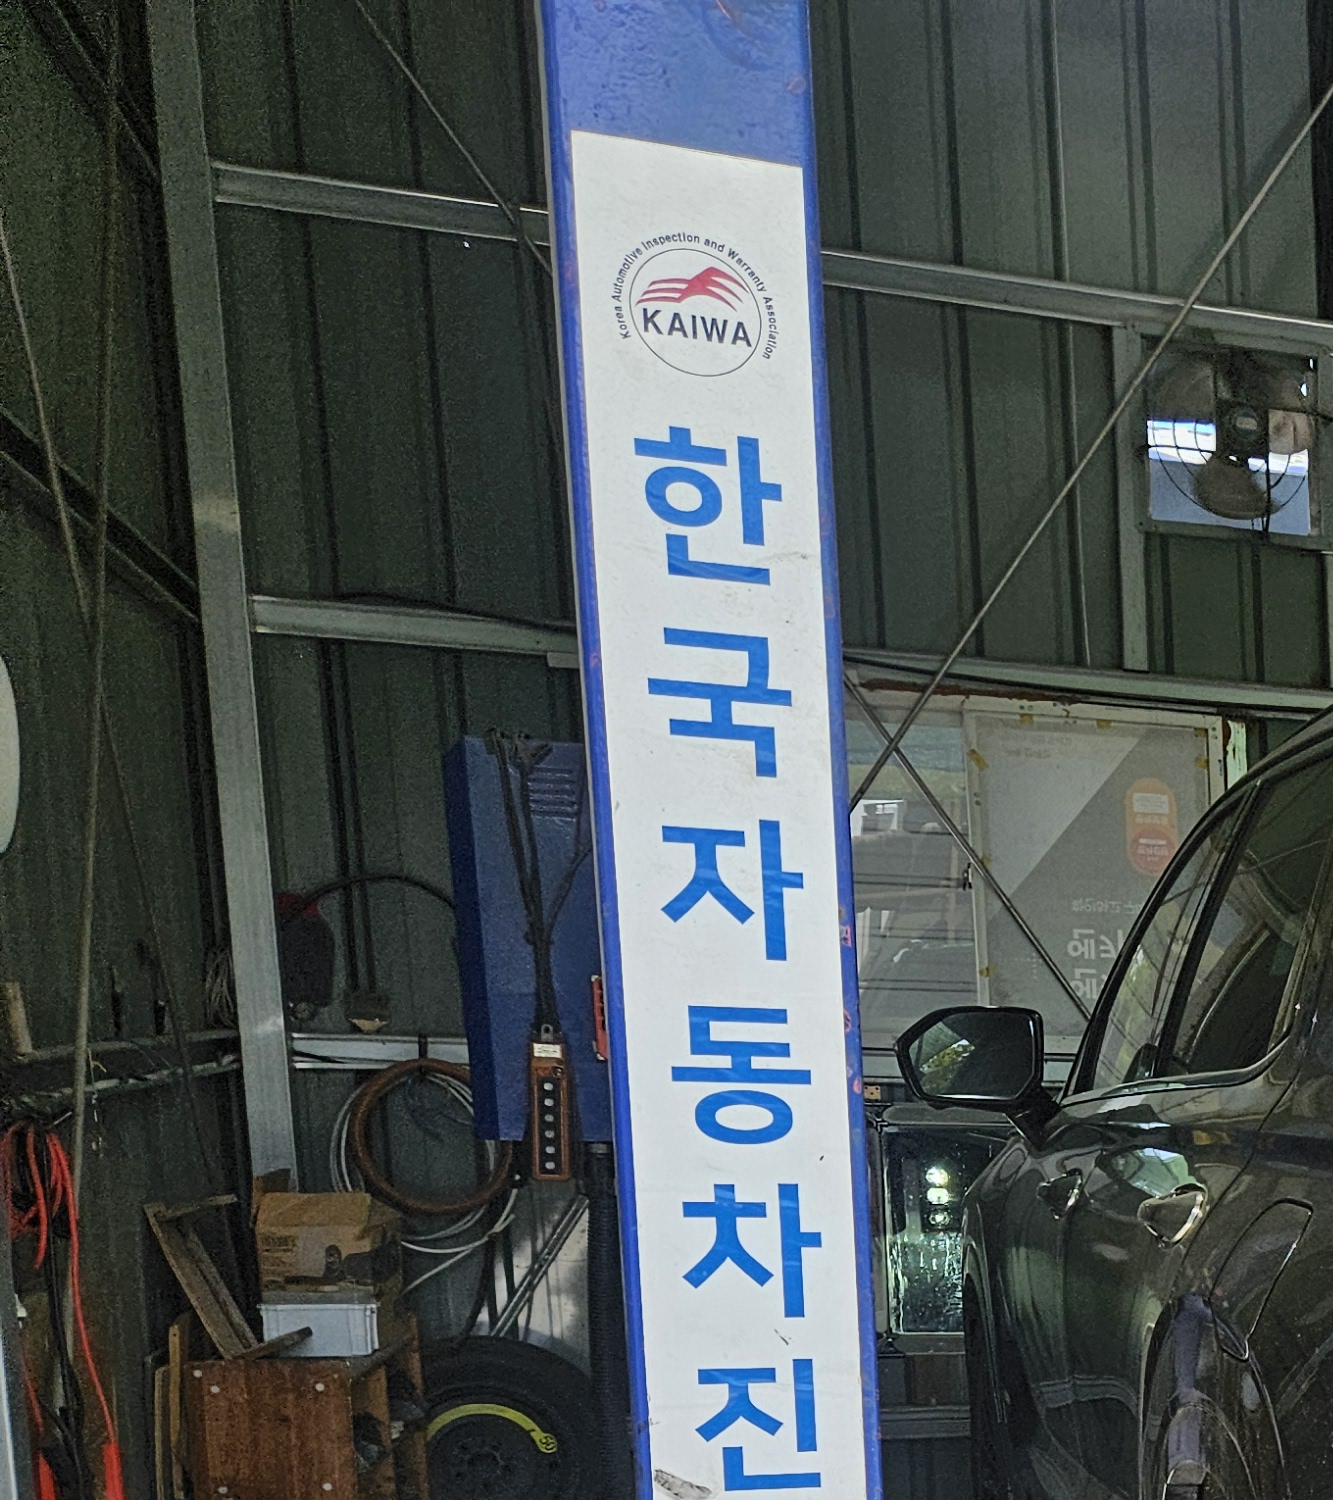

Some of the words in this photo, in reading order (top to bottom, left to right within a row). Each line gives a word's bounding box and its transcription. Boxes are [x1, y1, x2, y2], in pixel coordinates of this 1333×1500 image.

[641, 232, 700, 251] Inspection
[704, 238, 725, 252] and
[611, 247, 643, 302] Automotive
[727, 248, 767, 293] Warranty
[614, 305, 631, 340] Korea
[642, 307, 753, 348] KAIWA
[762, 296, 779, 360] Association
